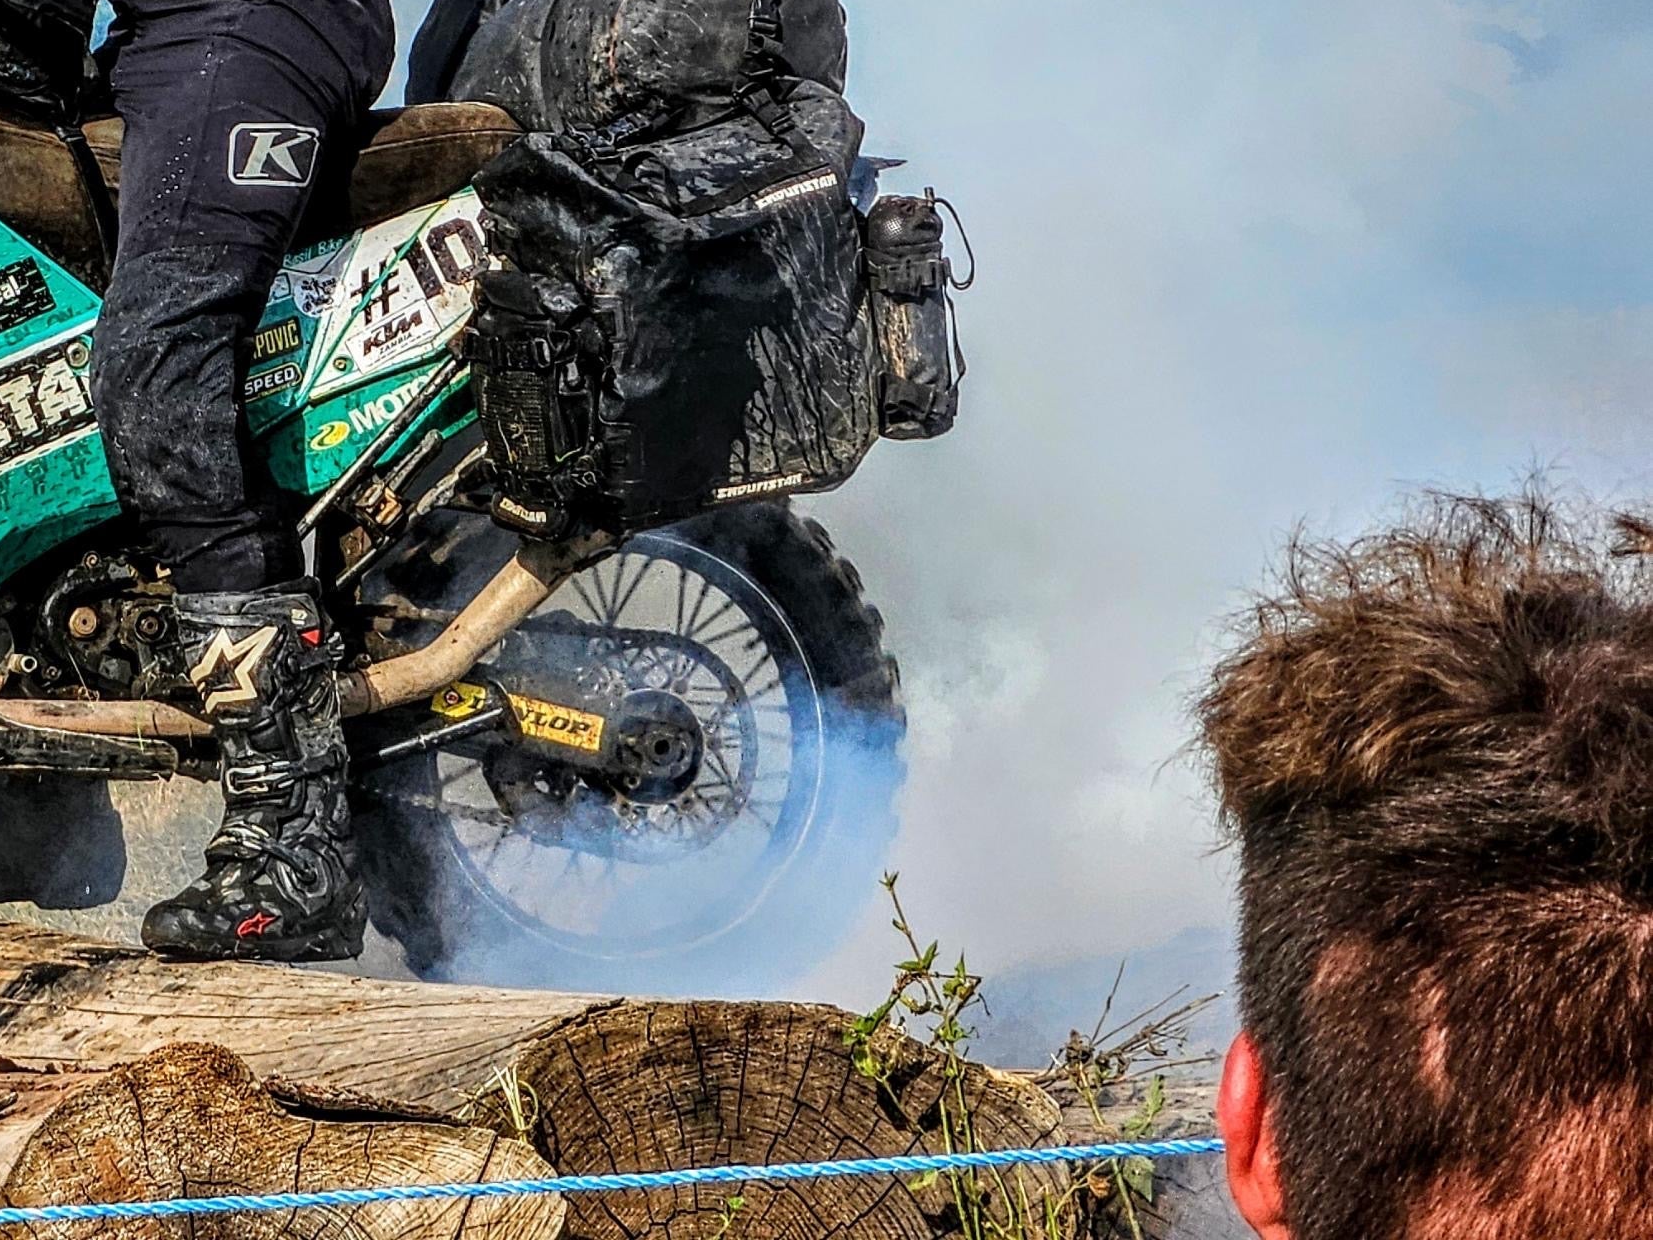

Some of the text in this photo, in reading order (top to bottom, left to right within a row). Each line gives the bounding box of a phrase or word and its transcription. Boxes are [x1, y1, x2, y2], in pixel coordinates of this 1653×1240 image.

[235, 131, 305, 180] K
[253, 321, 299, 360] POVIČ
[363, 310, 423, 357] KTM
[379, 331, 413, 355] ZAMBIA
[716, 473, 803, 500] ENDURISTAN
